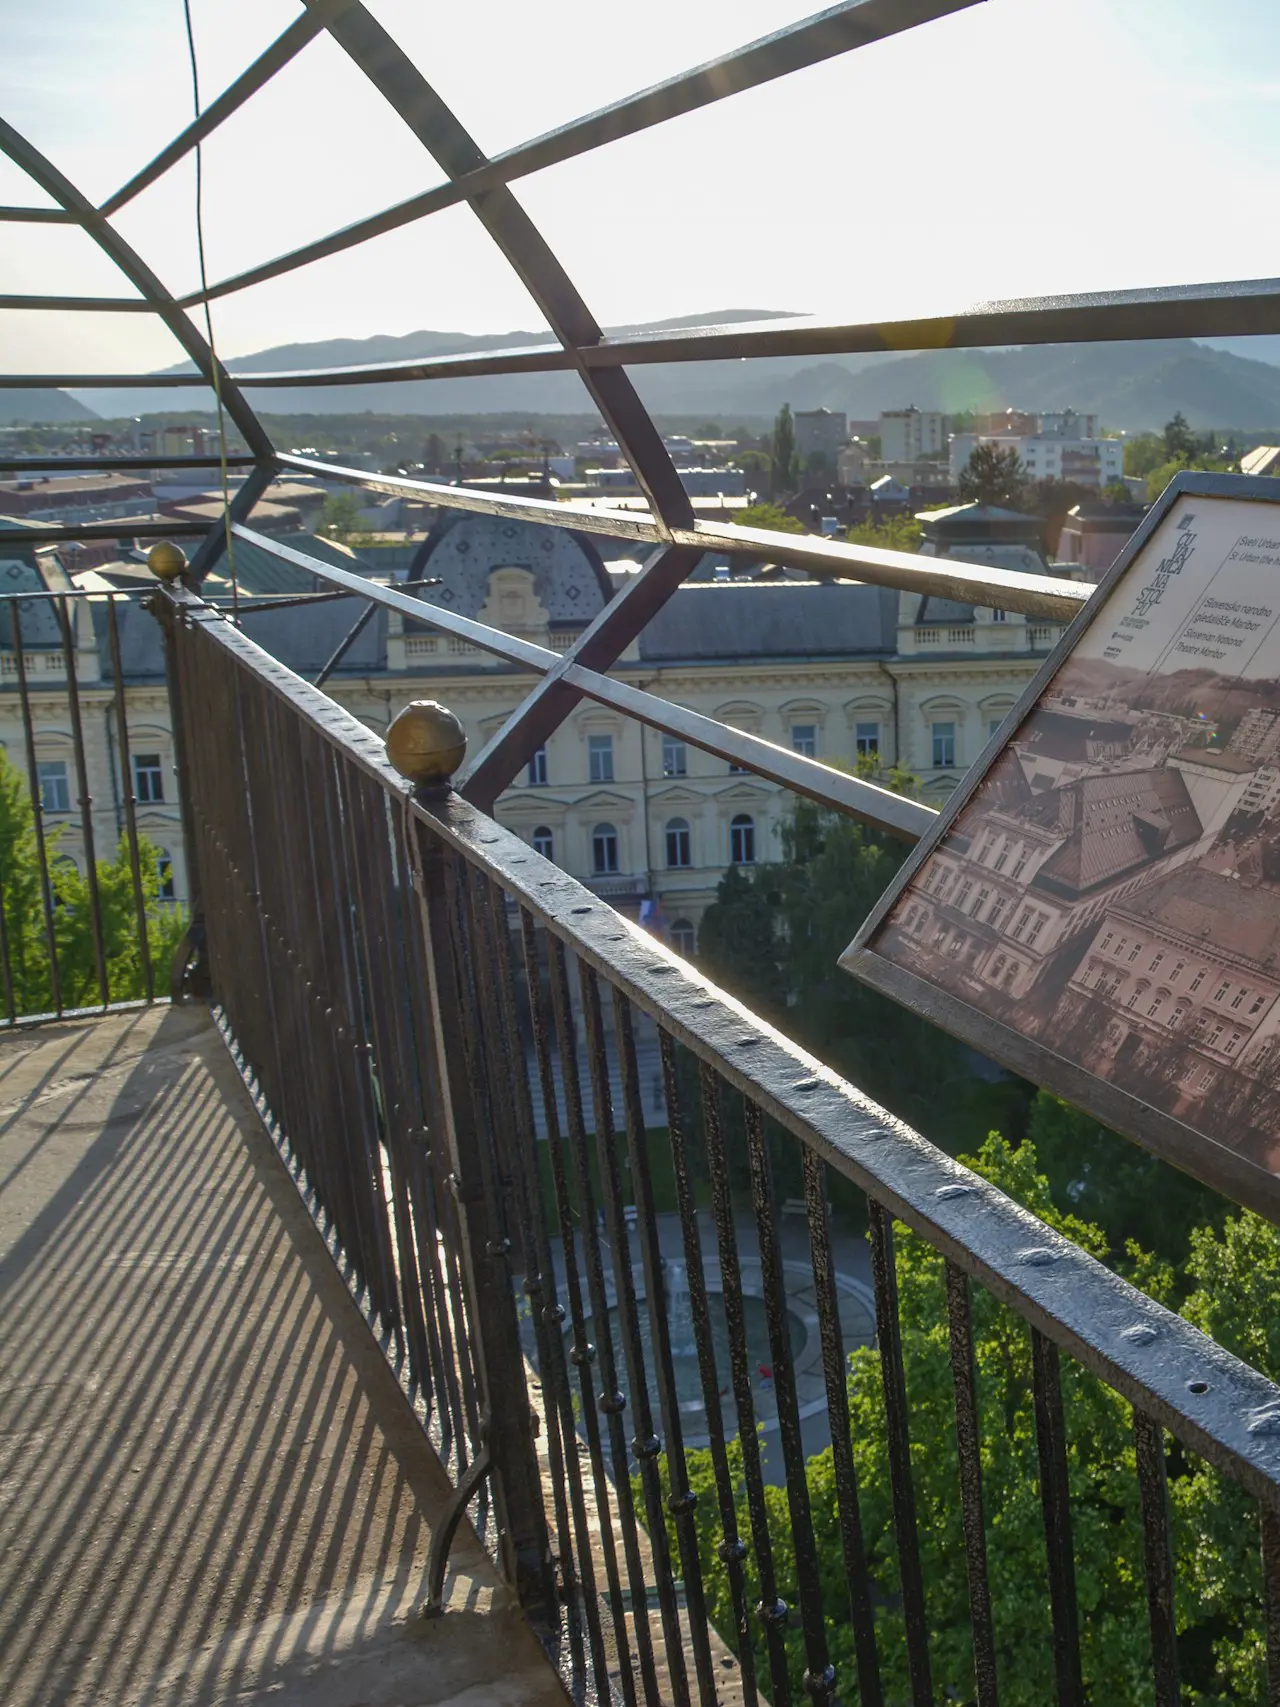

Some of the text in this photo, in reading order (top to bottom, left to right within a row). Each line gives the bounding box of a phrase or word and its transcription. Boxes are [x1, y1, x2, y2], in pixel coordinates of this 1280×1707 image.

[1257, 538, 1280, 550] Urban
[1150, 574, 1170, 588] NA
[1136, 587, 1164, 604] STOL
[1131, 601, 1153, 616] PU
[1203, 597, 1273, 618] Slovensko narodno
[1192, 612, 1262, 632] gledališče Maribor
[1183, 628, 1246, 648] Slovenian National
[1174, 641, 1227, 660] Theatre Maribor
